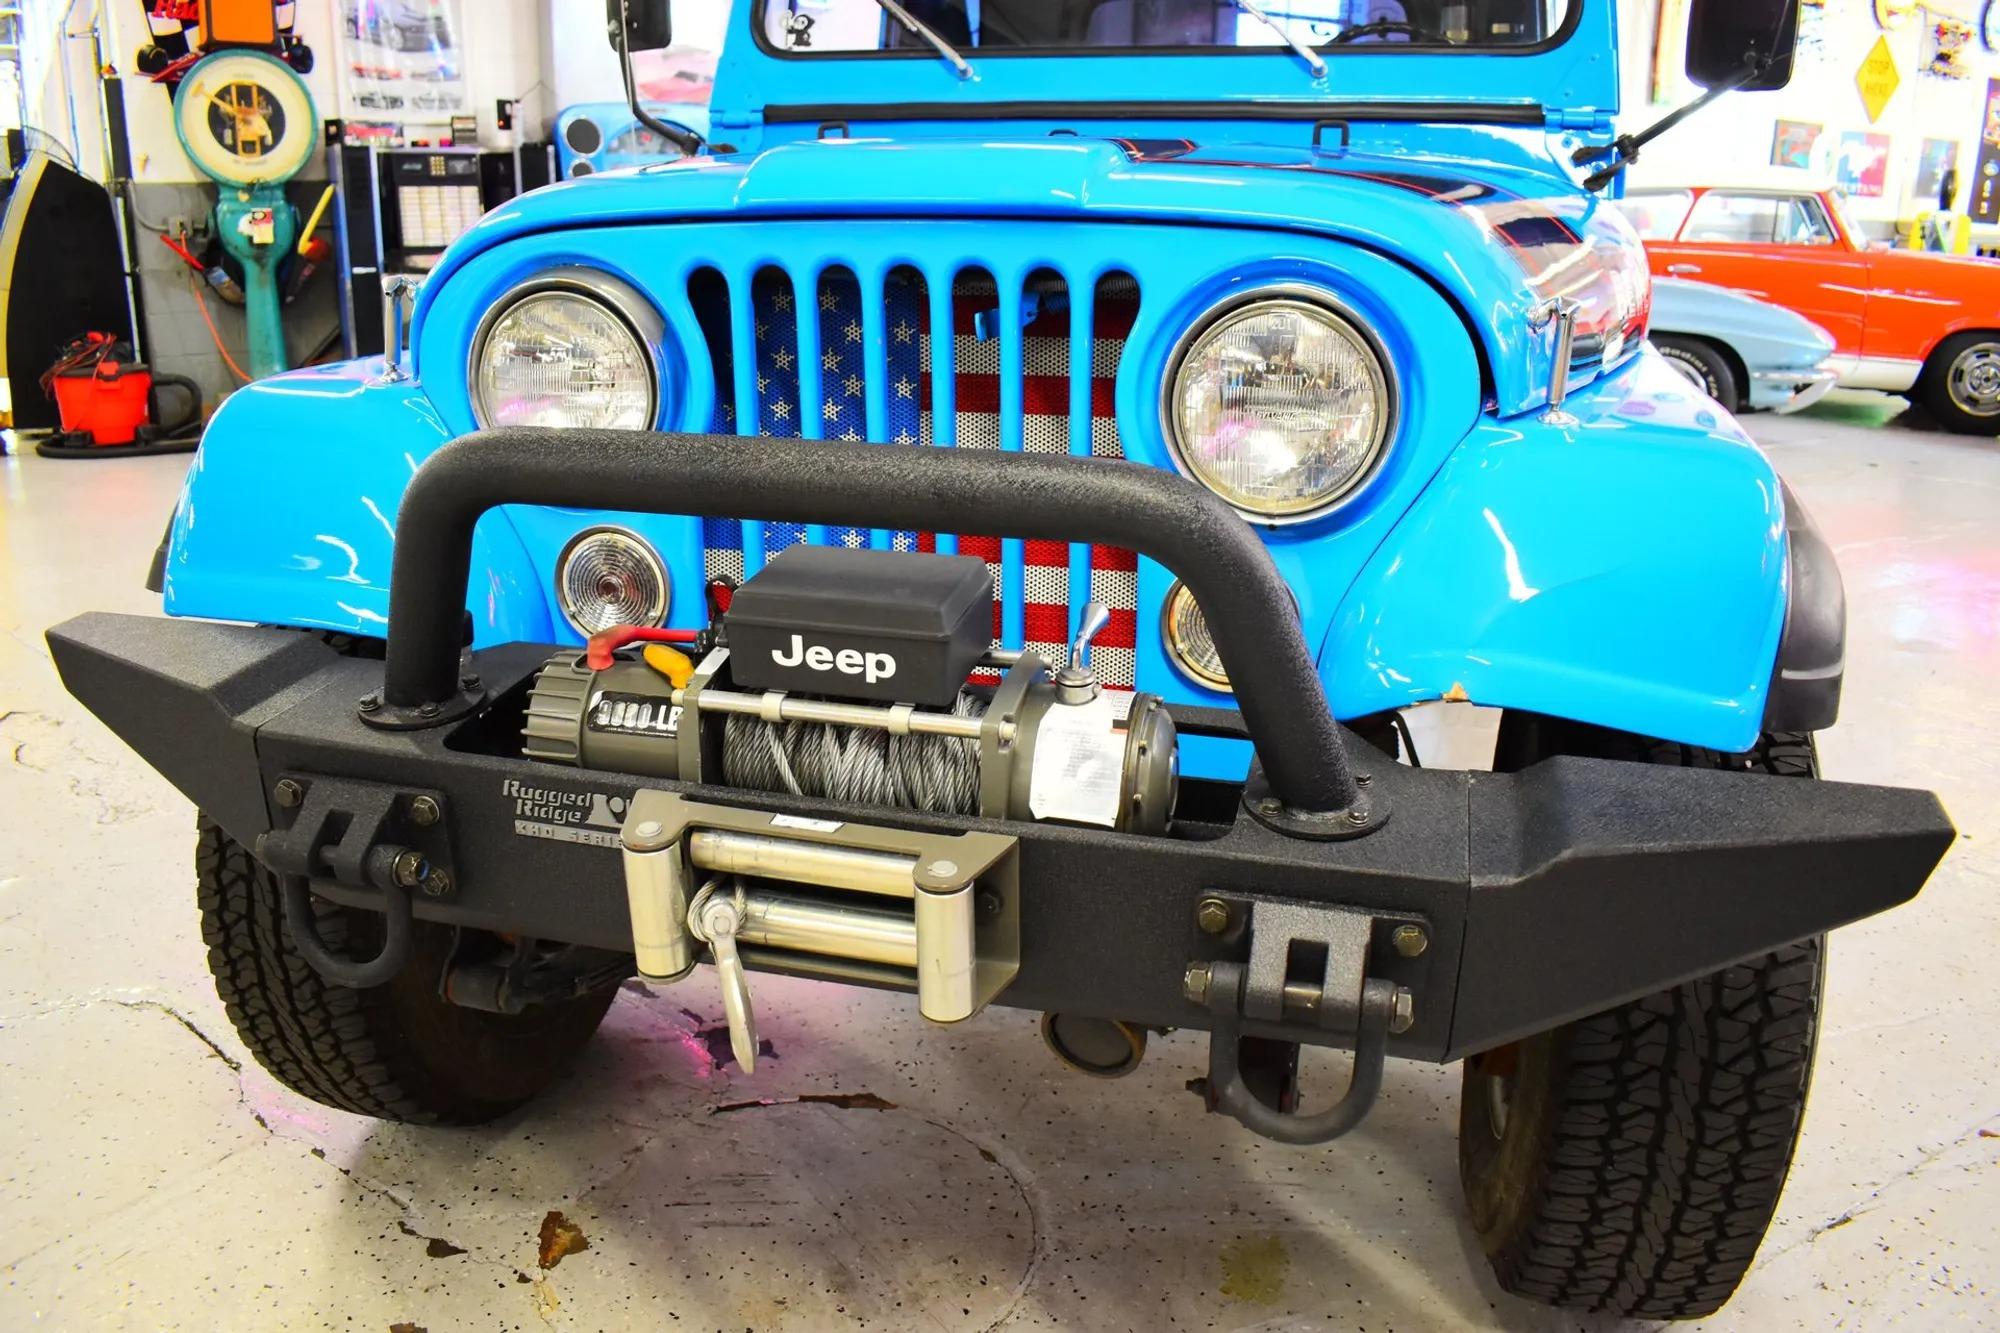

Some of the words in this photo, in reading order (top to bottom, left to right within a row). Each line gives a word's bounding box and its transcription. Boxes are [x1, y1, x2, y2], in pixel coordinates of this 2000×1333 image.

[771, 634, 897, 684] Jeep
[502, 779, 592, 807] Rugged
[515, 798, 582, 825] Ridge
